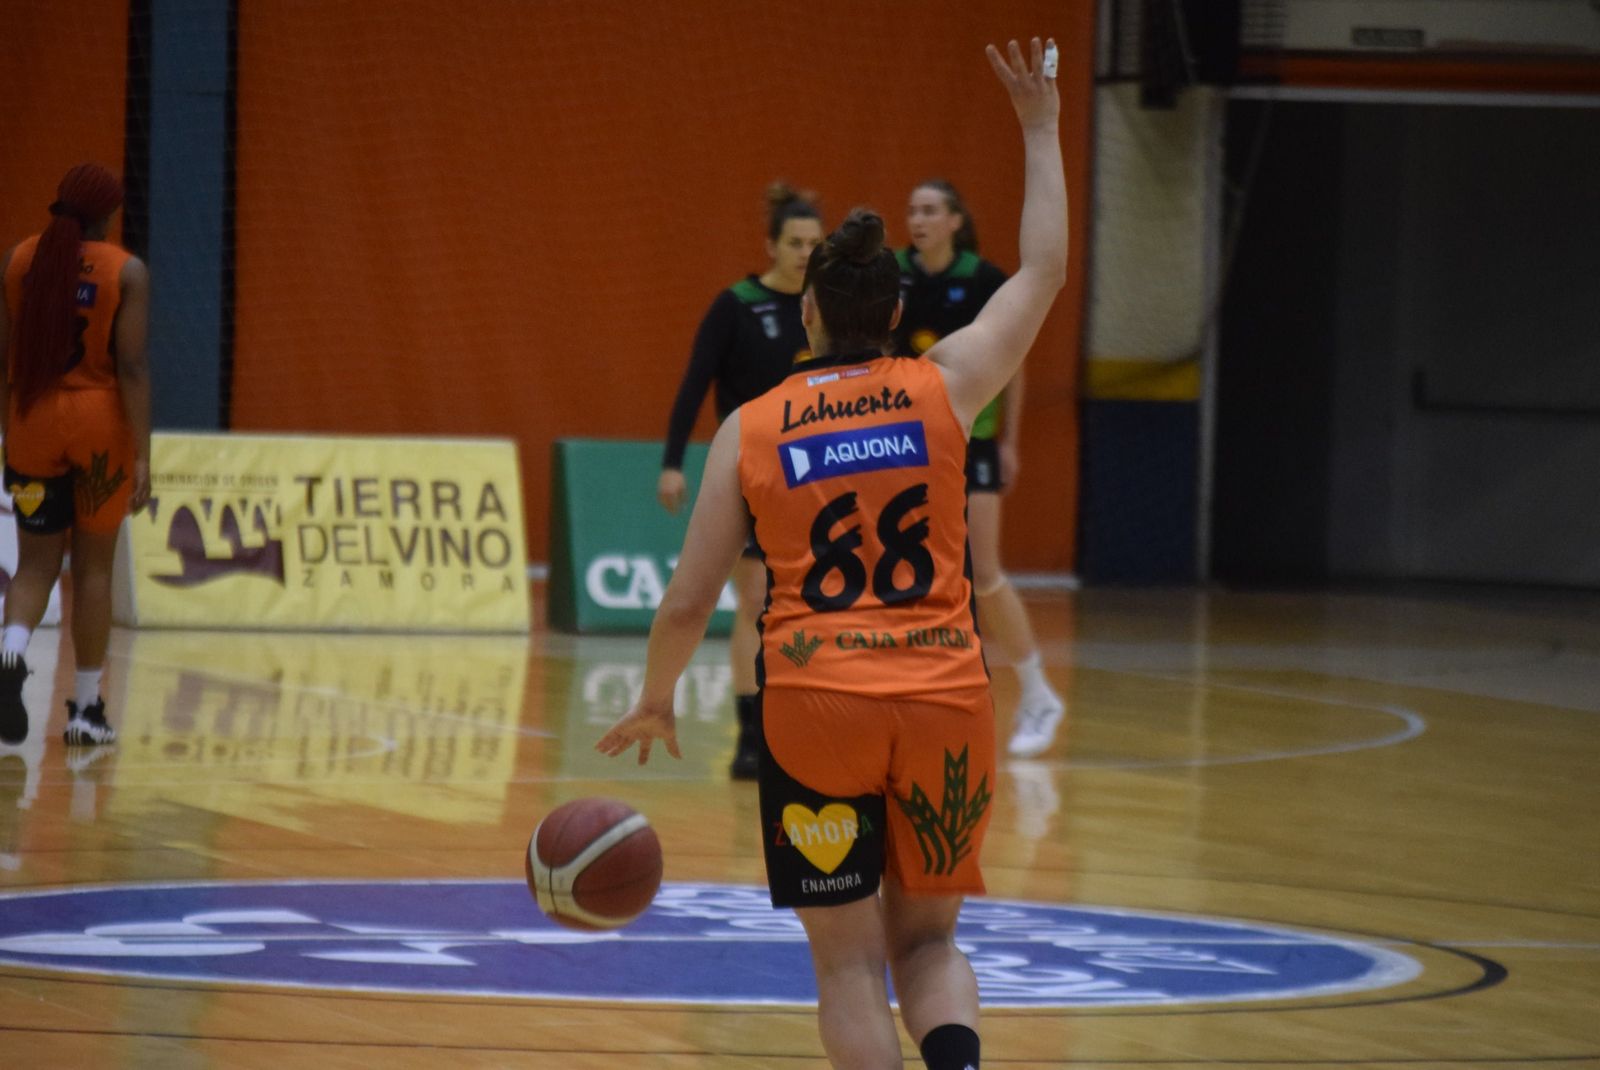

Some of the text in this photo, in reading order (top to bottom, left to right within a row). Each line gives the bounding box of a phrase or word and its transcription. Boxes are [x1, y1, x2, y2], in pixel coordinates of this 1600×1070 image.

[779, 385, 913, 434] Lahuerta
[823, 434, 917, 466] AQUONA
[293, 475, 508, 521] TIERRA
[302, 570, 516, 592] ZAMORA
[835, 631, 898, 650] CAJA
[773, 814, 873, 847] ZAMORA
[801, 872, 862, 894] ENAMORA
